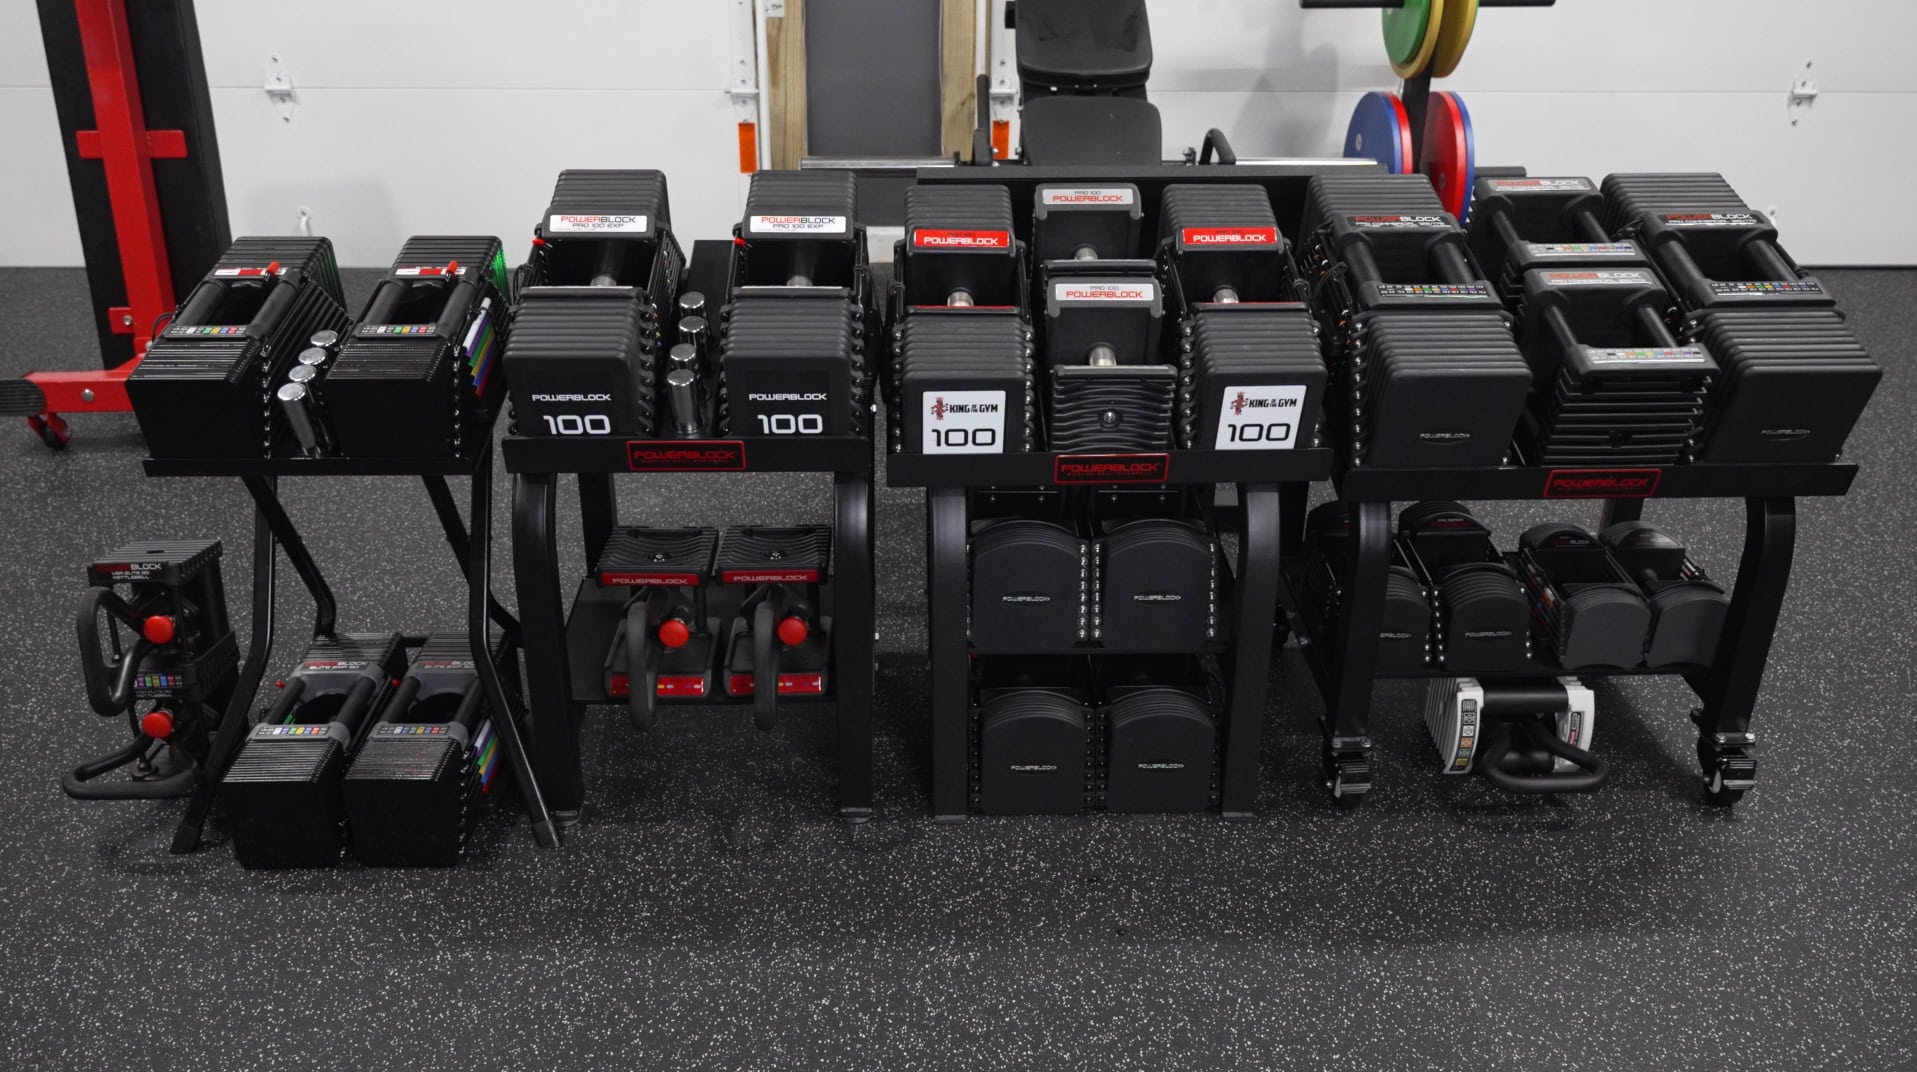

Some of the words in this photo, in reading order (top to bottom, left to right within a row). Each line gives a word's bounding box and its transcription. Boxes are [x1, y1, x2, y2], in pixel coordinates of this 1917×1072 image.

[560, 215, 636, 223] POWERBLOCK
[761, 216, 836, 224] POWERBLOCK
[923, 236, 998, 245] POWERBLOCK
[1192, 234, 1266, 242] POWERBLOCK
[531, 394, 611, 402] POWERBLOCK
[748, 393, 827, 401] POWERBLOCK
[1248, 399, 1269, 408] KING
[1278, 398, 1298, 408] GYM
[949, 404, 970, 413] KING
[979, 404, 998, 413] GYM
[543, 415, 611, 435] 100
[757, 414, 823, 434] 100
[1227, 423, 1291, 442] 100
[931, 428, 997, 447] 100
[634, 451, 735, 460] POWERBLOCK
[1061, 463, 1158, 472] POWERBLOCK
[1553, 479, 1648, 488] POWERBLOCK
